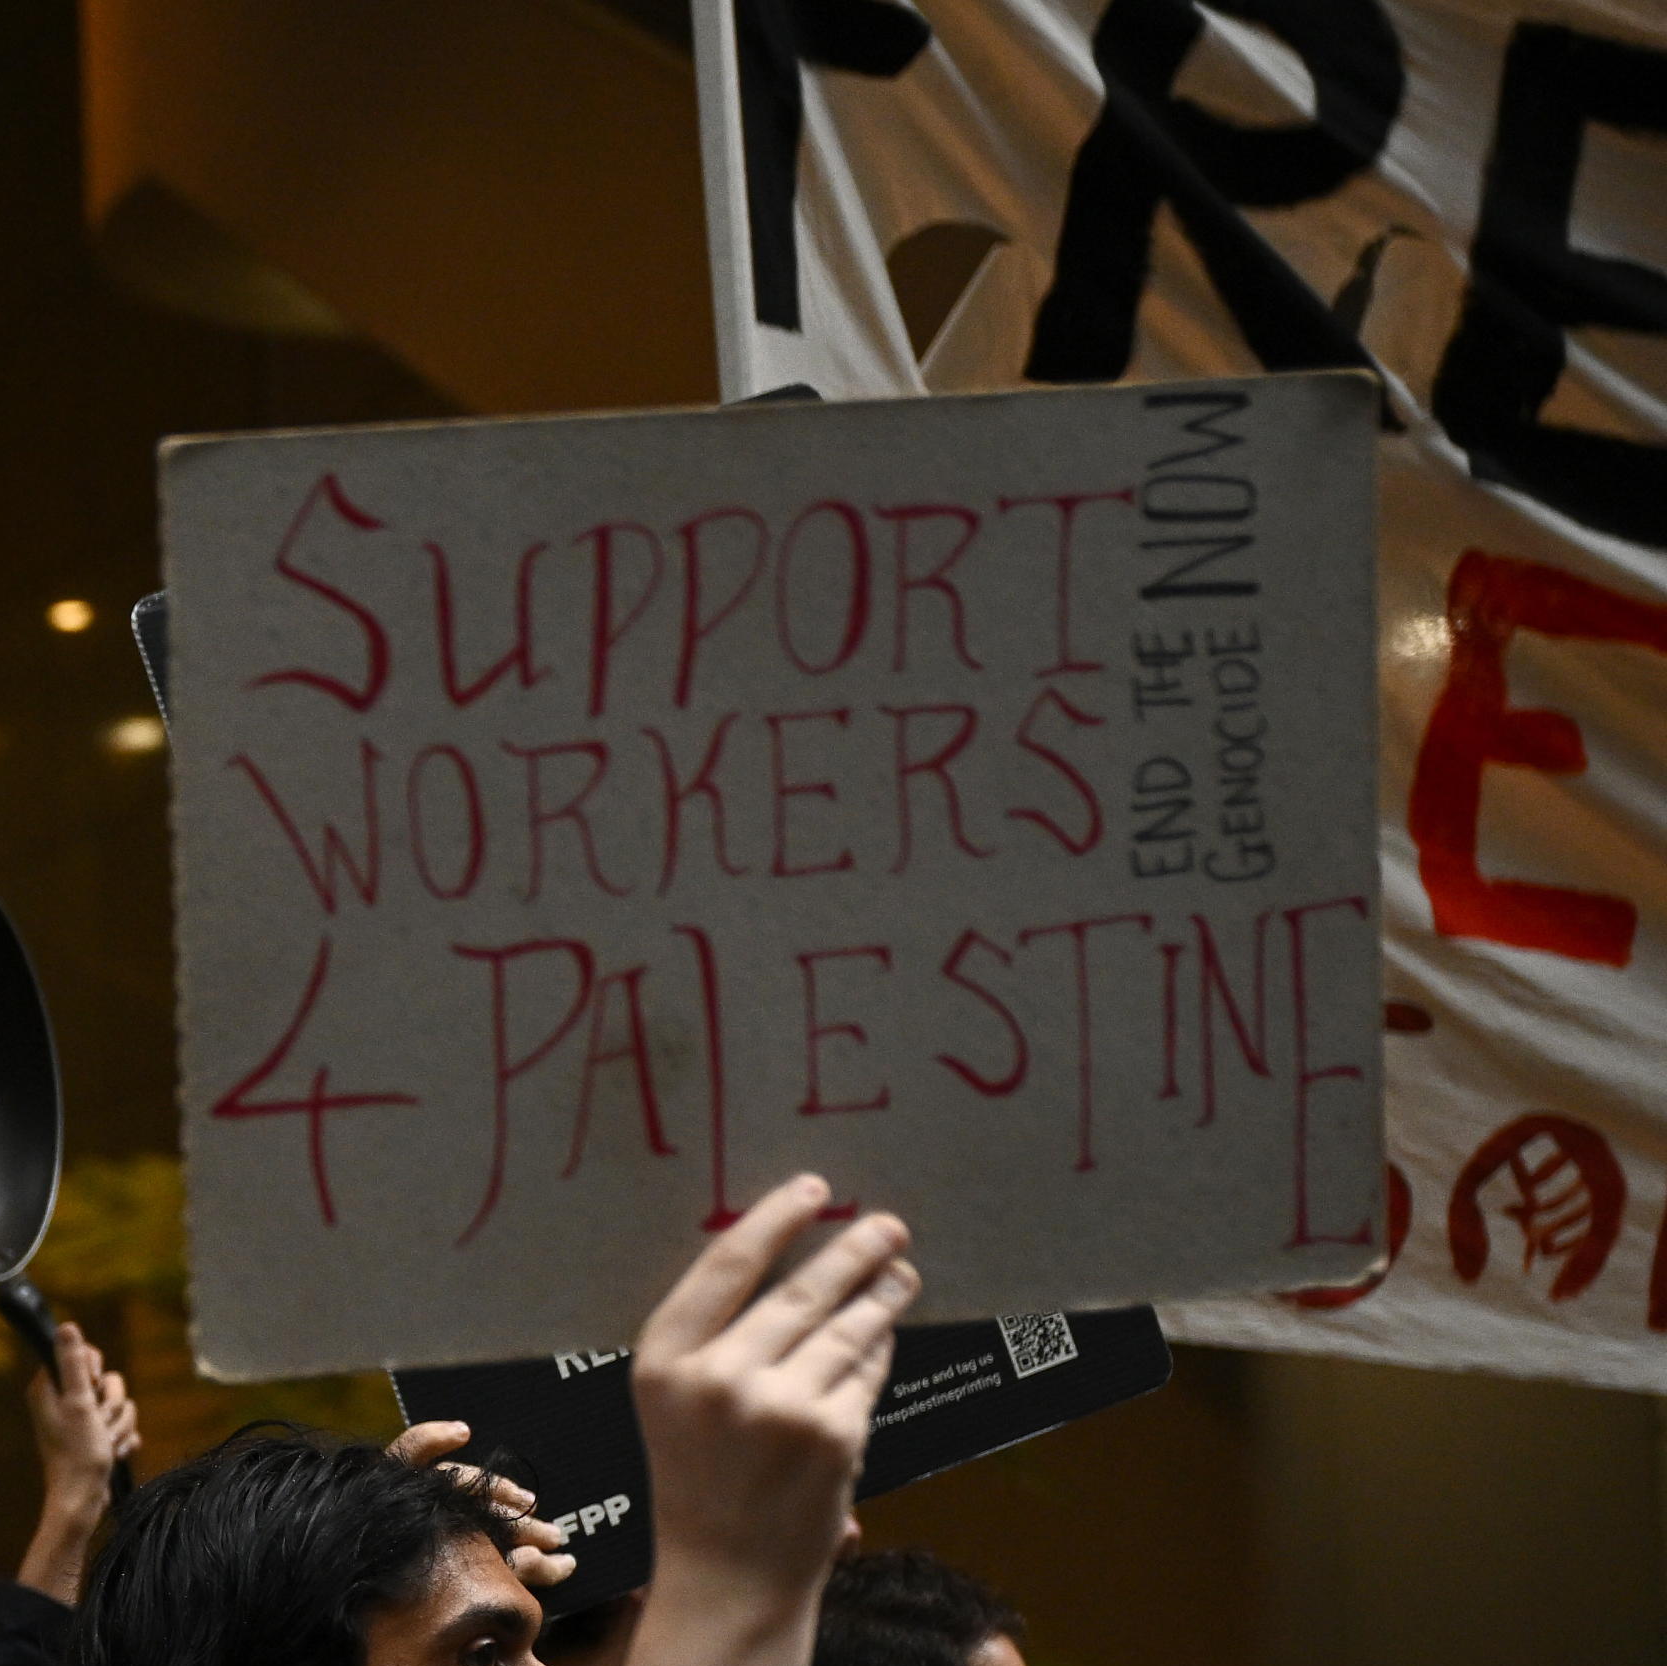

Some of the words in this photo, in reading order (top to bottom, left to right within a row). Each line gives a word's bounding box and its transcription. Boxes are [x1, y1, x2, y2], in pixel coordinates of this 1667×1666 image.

[249, 472, 1137, 726] SUPPORT
[1139, 391, 1261, 601] NOW
[1131, 626, 1196, 723] THE
[1203, 622, 1276, 883] GENOCIDE
[229, 687, 1107, 914] WORKERS
[1130, 756, 1197, 880] END
[208, 936, 421, 1228] 4
[452, 895, 1373, 1247] PALESTINE
[893, 1376, 930, 1399] Share
[932, 1364, 954, 1385] and
[956, 1358, 978, 1375] tag
[978, 1352, 994, 1367] us
[553, 1493, 631, 1547] FPP
